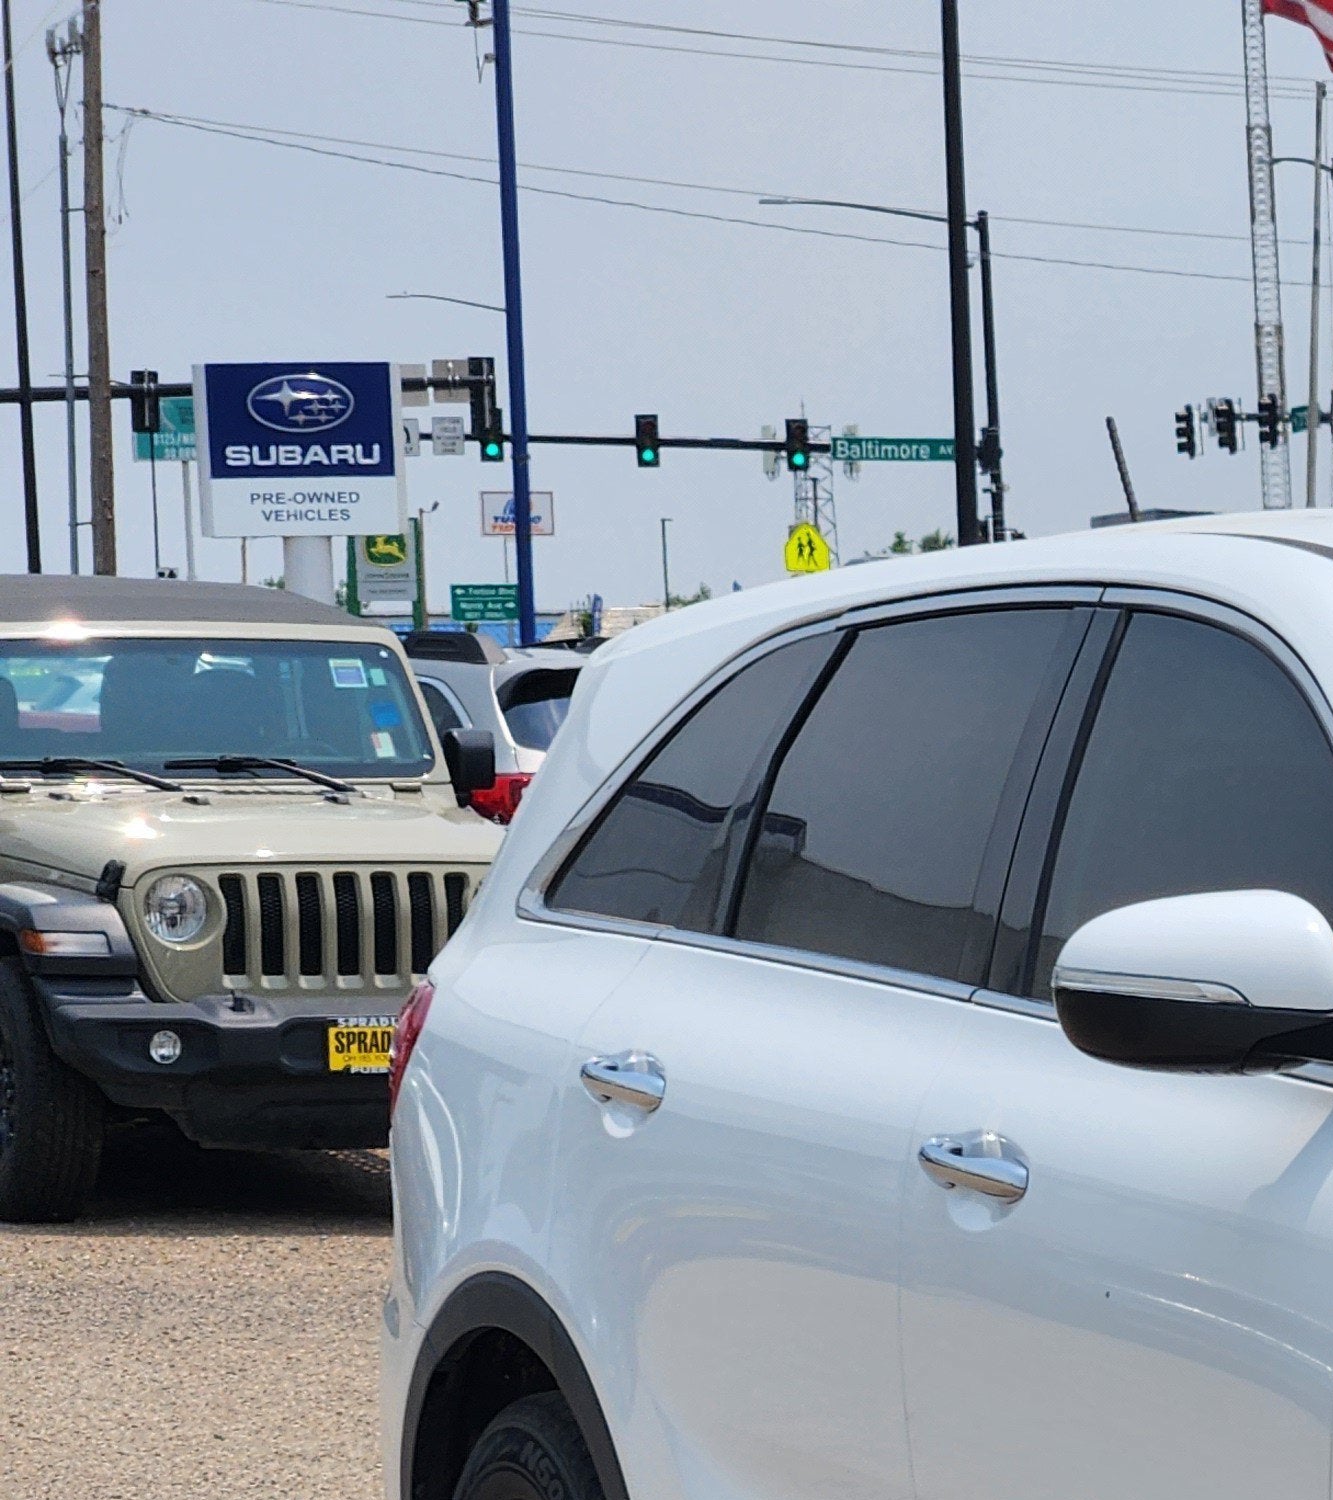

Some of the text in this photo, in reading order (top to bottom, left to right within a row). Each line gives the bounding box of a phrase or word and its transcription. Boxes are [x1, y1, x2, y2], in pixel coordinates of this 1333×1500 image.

[225, 443, 381, 466] SUBARU
[836, 440, 931, 459] Baltimore
[250, 491, 361, 505] PRE-OWNED
[261, 508, 352, 522] VEHICLES
[337, 1016, 398, 1029] SPRAD
[334, 1030, 391, 1055] SPRAD
